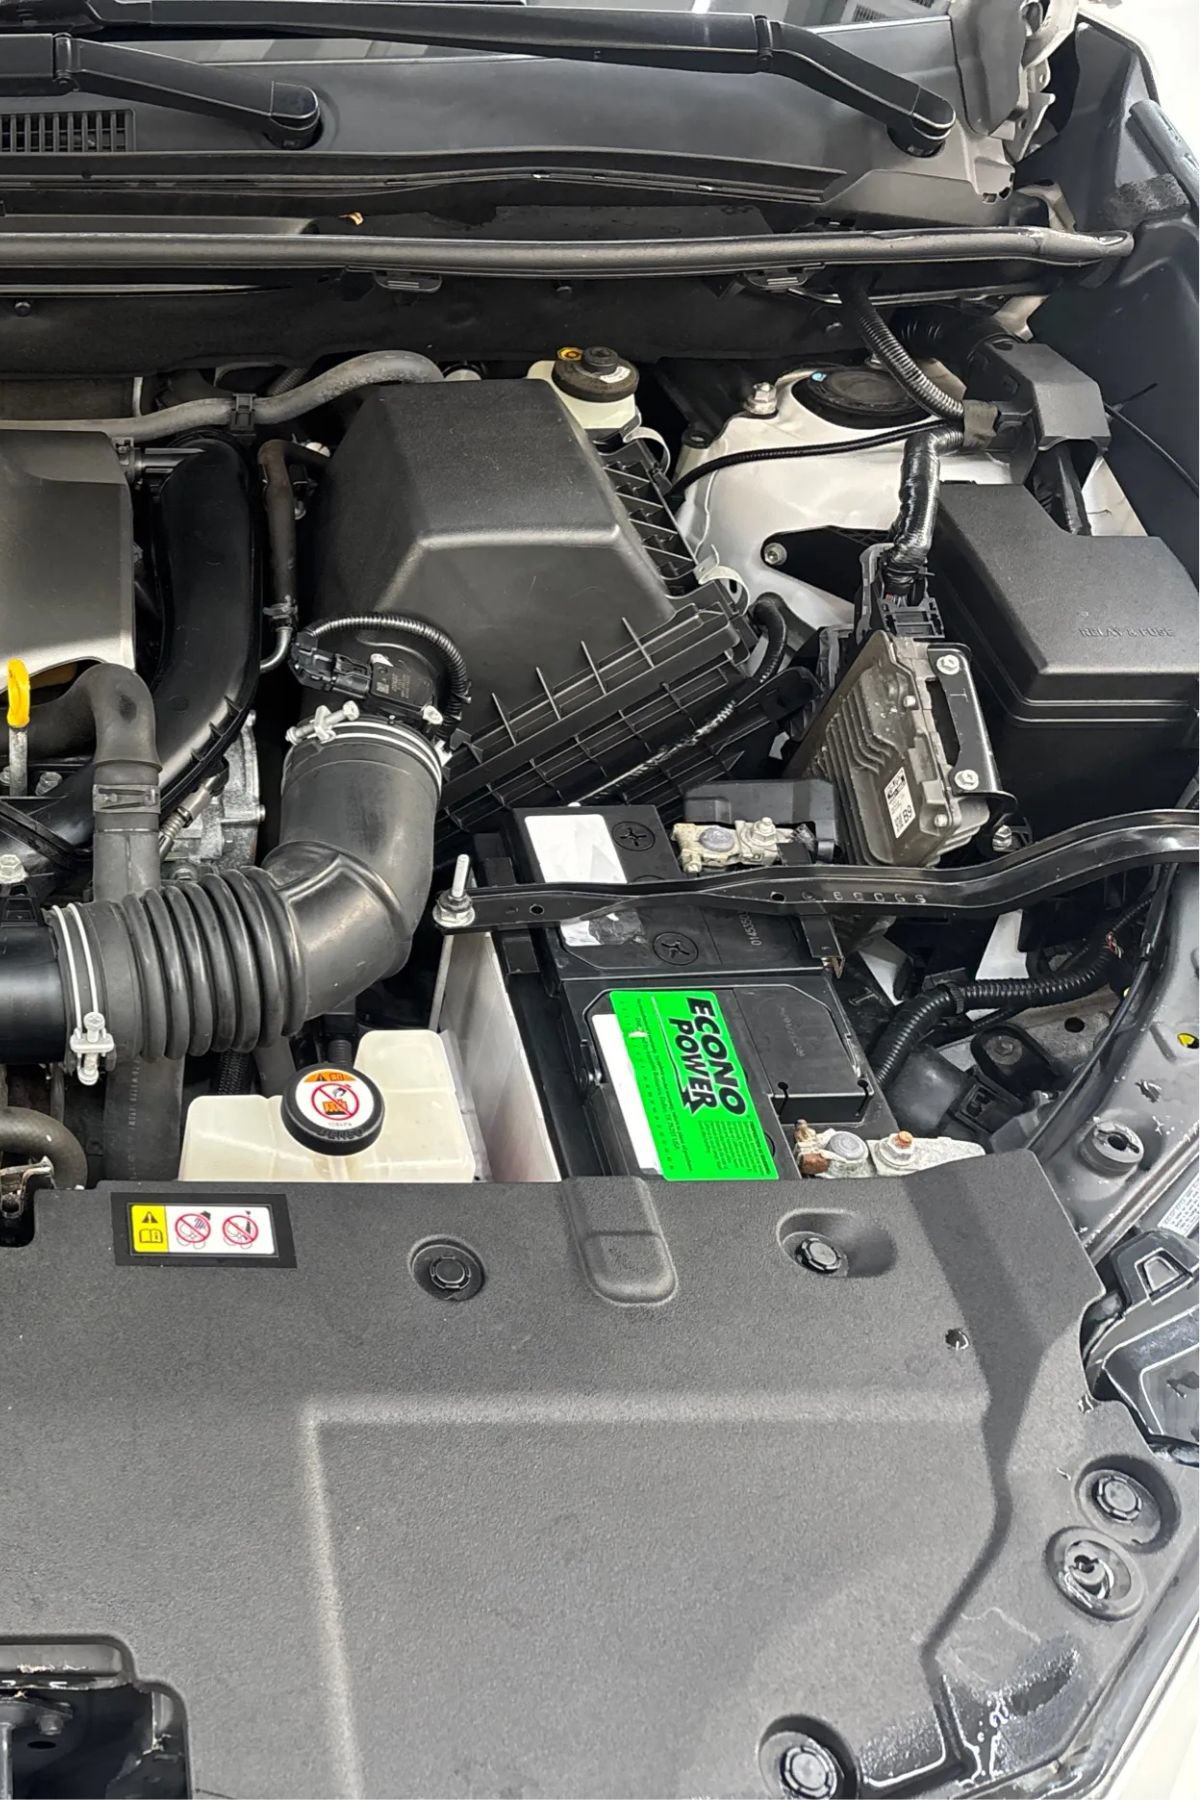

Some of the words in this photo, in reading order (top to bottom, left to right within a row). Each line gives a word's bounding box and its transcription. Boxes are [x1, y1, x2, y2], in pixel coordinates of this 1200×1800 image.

[1078, 626, 1122, 637] RELAY
[668, 1017, 720, 1111] POWER
[686, 996, 748, 1116] ECONO
